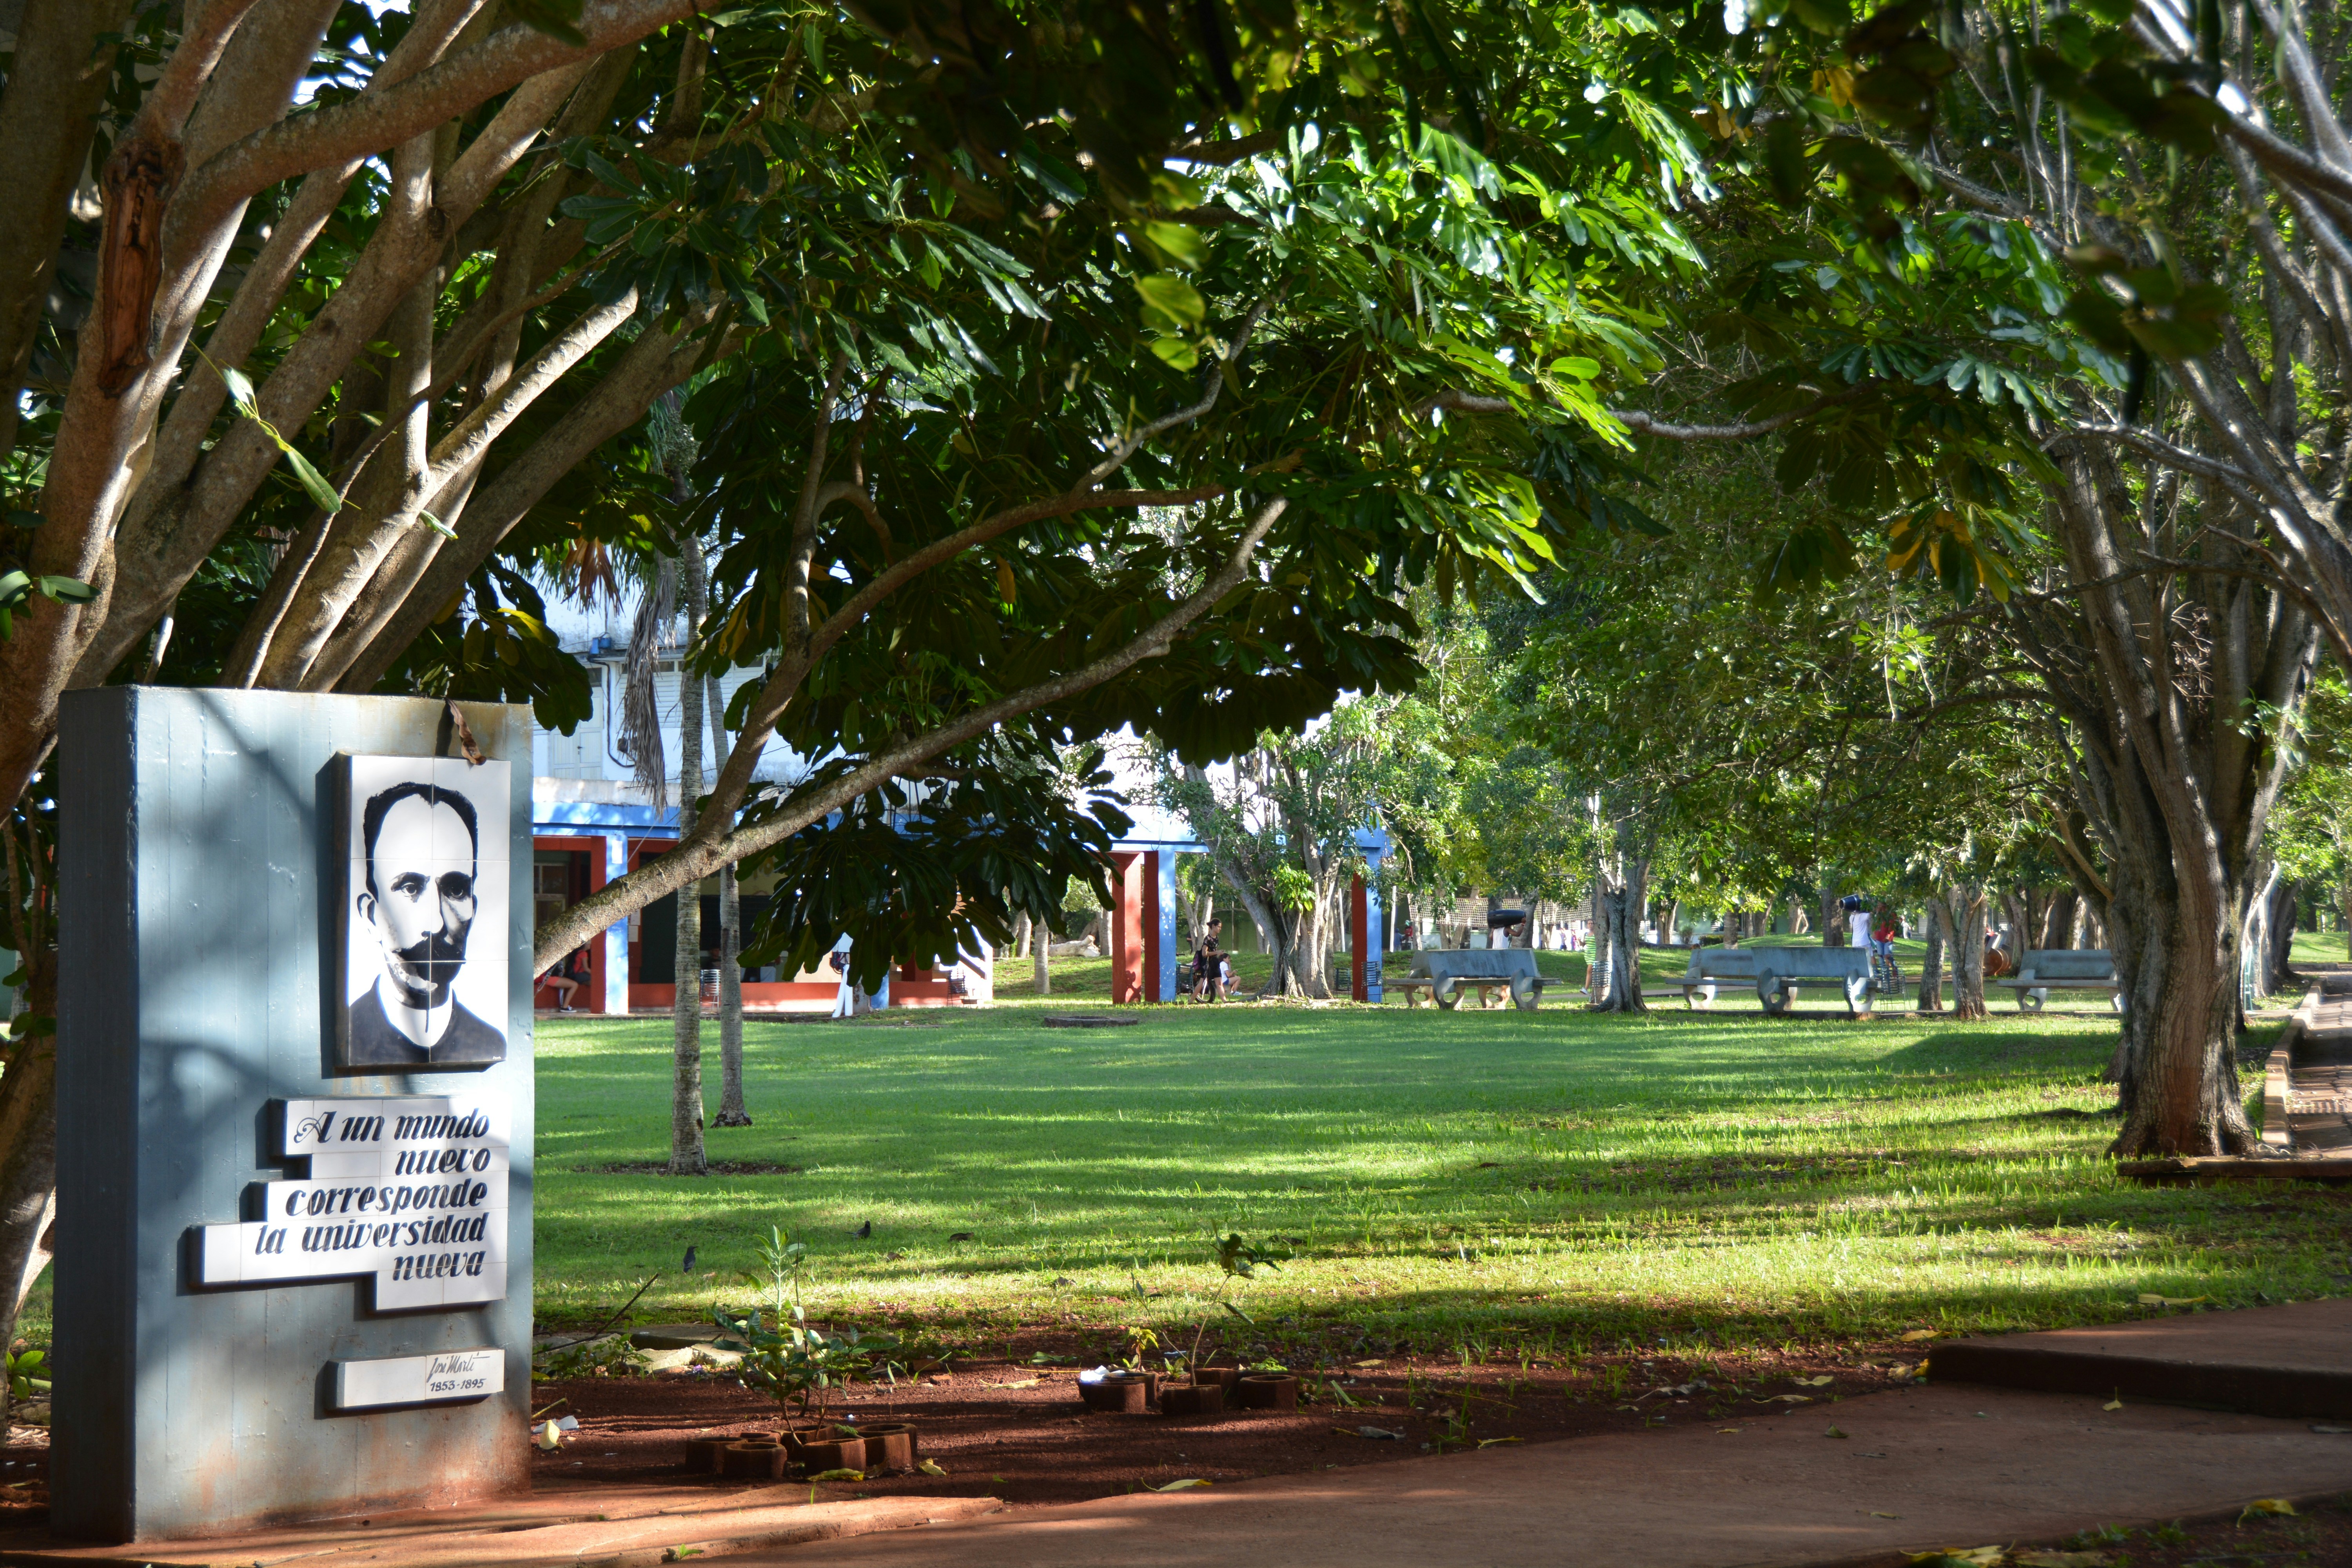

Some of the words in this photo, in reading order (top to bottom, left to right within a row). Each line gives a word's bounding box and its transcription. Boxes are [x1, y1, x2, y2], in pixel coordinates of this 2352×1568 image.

[294, 1111, 337, 1143] A
[340, 1115, 385, 1142] un
[394, 1108, 490, 1140] mundo
[394, 1148, 491, 1176] nuevo
[285, 1178, 488, 1215] corresponde
[255, 1225, 287, 1255] la
[301, 1212, 489, 1252] universidad
[392, 1250, 486, 1281] nueva
[430, 1378, 487, 1392] 1853-1895
